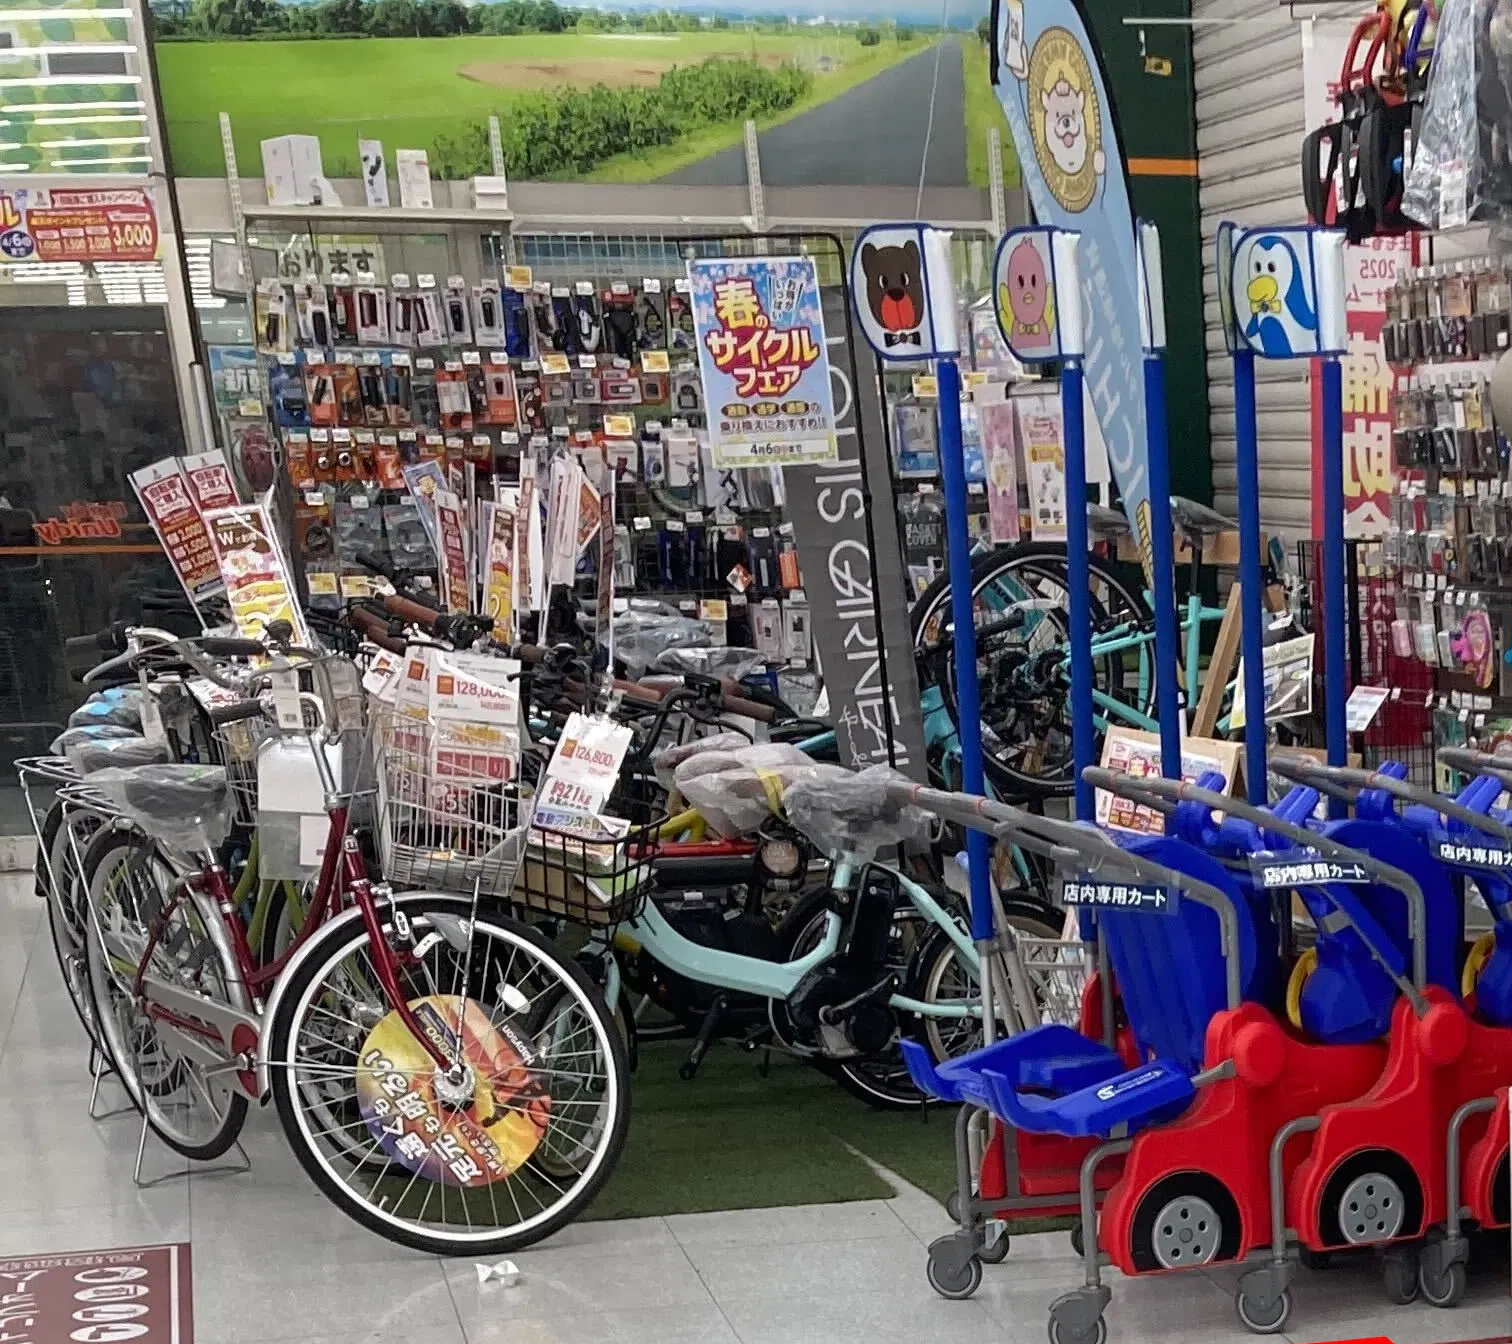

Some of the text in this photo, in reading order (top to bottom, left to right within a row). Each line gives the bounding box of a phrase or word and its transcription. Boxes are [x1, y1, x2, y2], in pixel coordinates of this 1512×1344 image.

[112, 224, 152, 247] 3,000
[714, 280, 769, 329] 春の
[706, 330, 818, 367] サイクル
[732, 365, 802, 395] フェア
[1264, 863, 1365, 883] 店内専用カート
[1063, 883, 1166, 907] 店内専用カート
[502, 1024, 535, 1065] Hapyson
[364, 1049, 484, 1184] 足元も明るい
[374, 1098, 429, 1160] 遠くも
